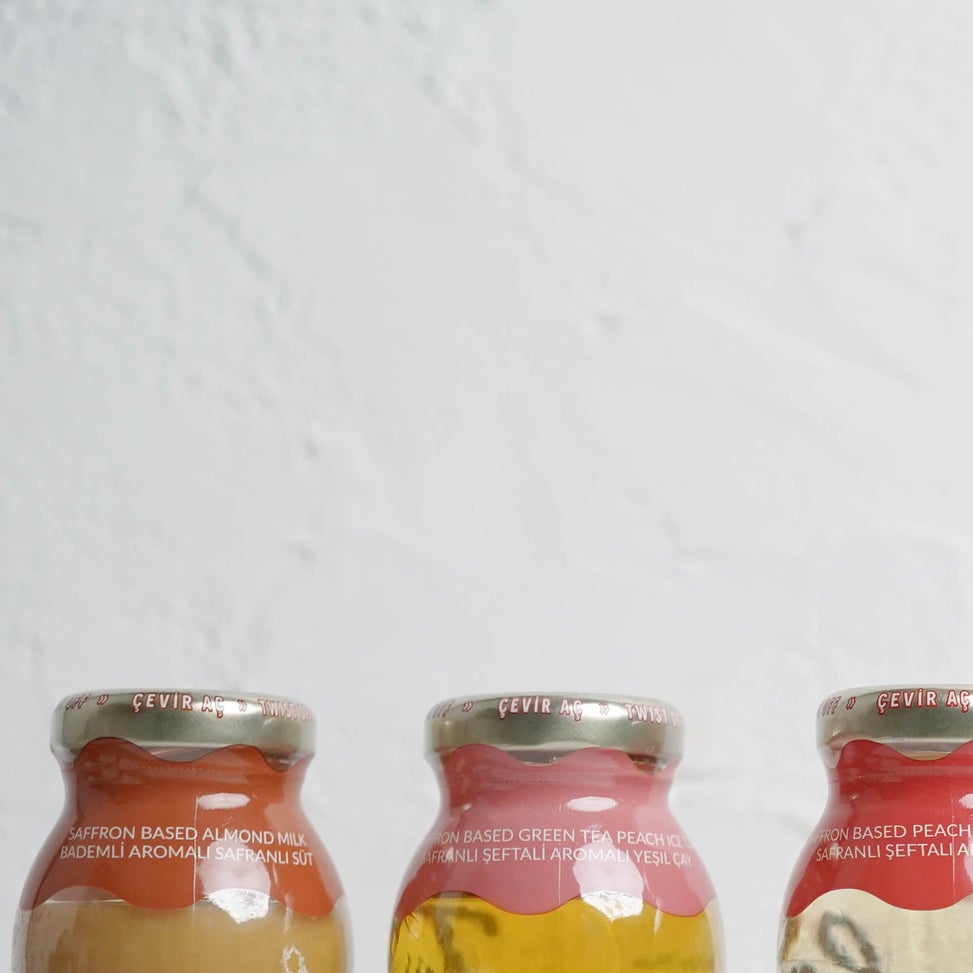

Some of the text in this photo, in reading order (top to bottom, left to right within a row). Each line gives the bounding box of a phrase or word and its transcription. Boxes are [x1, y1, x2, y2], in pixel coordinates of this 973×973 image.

[132, 691, 194, 716] ÇEVİR
[201, 695, 226, 718] AÇ
[498, 696, 551, 720] ÇEVİR
[559, 699, 584, 722] AÇ
[624, 702, 668, 727] TWIST
[876, 688, 938, 715] ÇEVİR
[946, 690, 971, 713] AÇ
[68, 826, 307, 848] SAFFRON BASED ALMOND MILK
[463, 828, 514, 844] BASED
[519, 828, 575, 842] GREEN
[580, 829, 613, 844] TEA
[617, 830, 665, 847] PEACH
[666, 834, 684, 848] ICE
[853, 824, 907, 841] BASED
[912, 824, 972, 839] PEACH
[60, 841, 314, 867] BADEMLİ AROMALI SAFRANLI SÜT
[483, 843, 545, 865] ŞEFTALİ
[550, 847, 631, 863] AROMALI
[672, 851, 693, 868] ÇAY
[815, 843, 881, 862] SAFRANLI
[885, 842, 953, 861] ŞEFTALI
